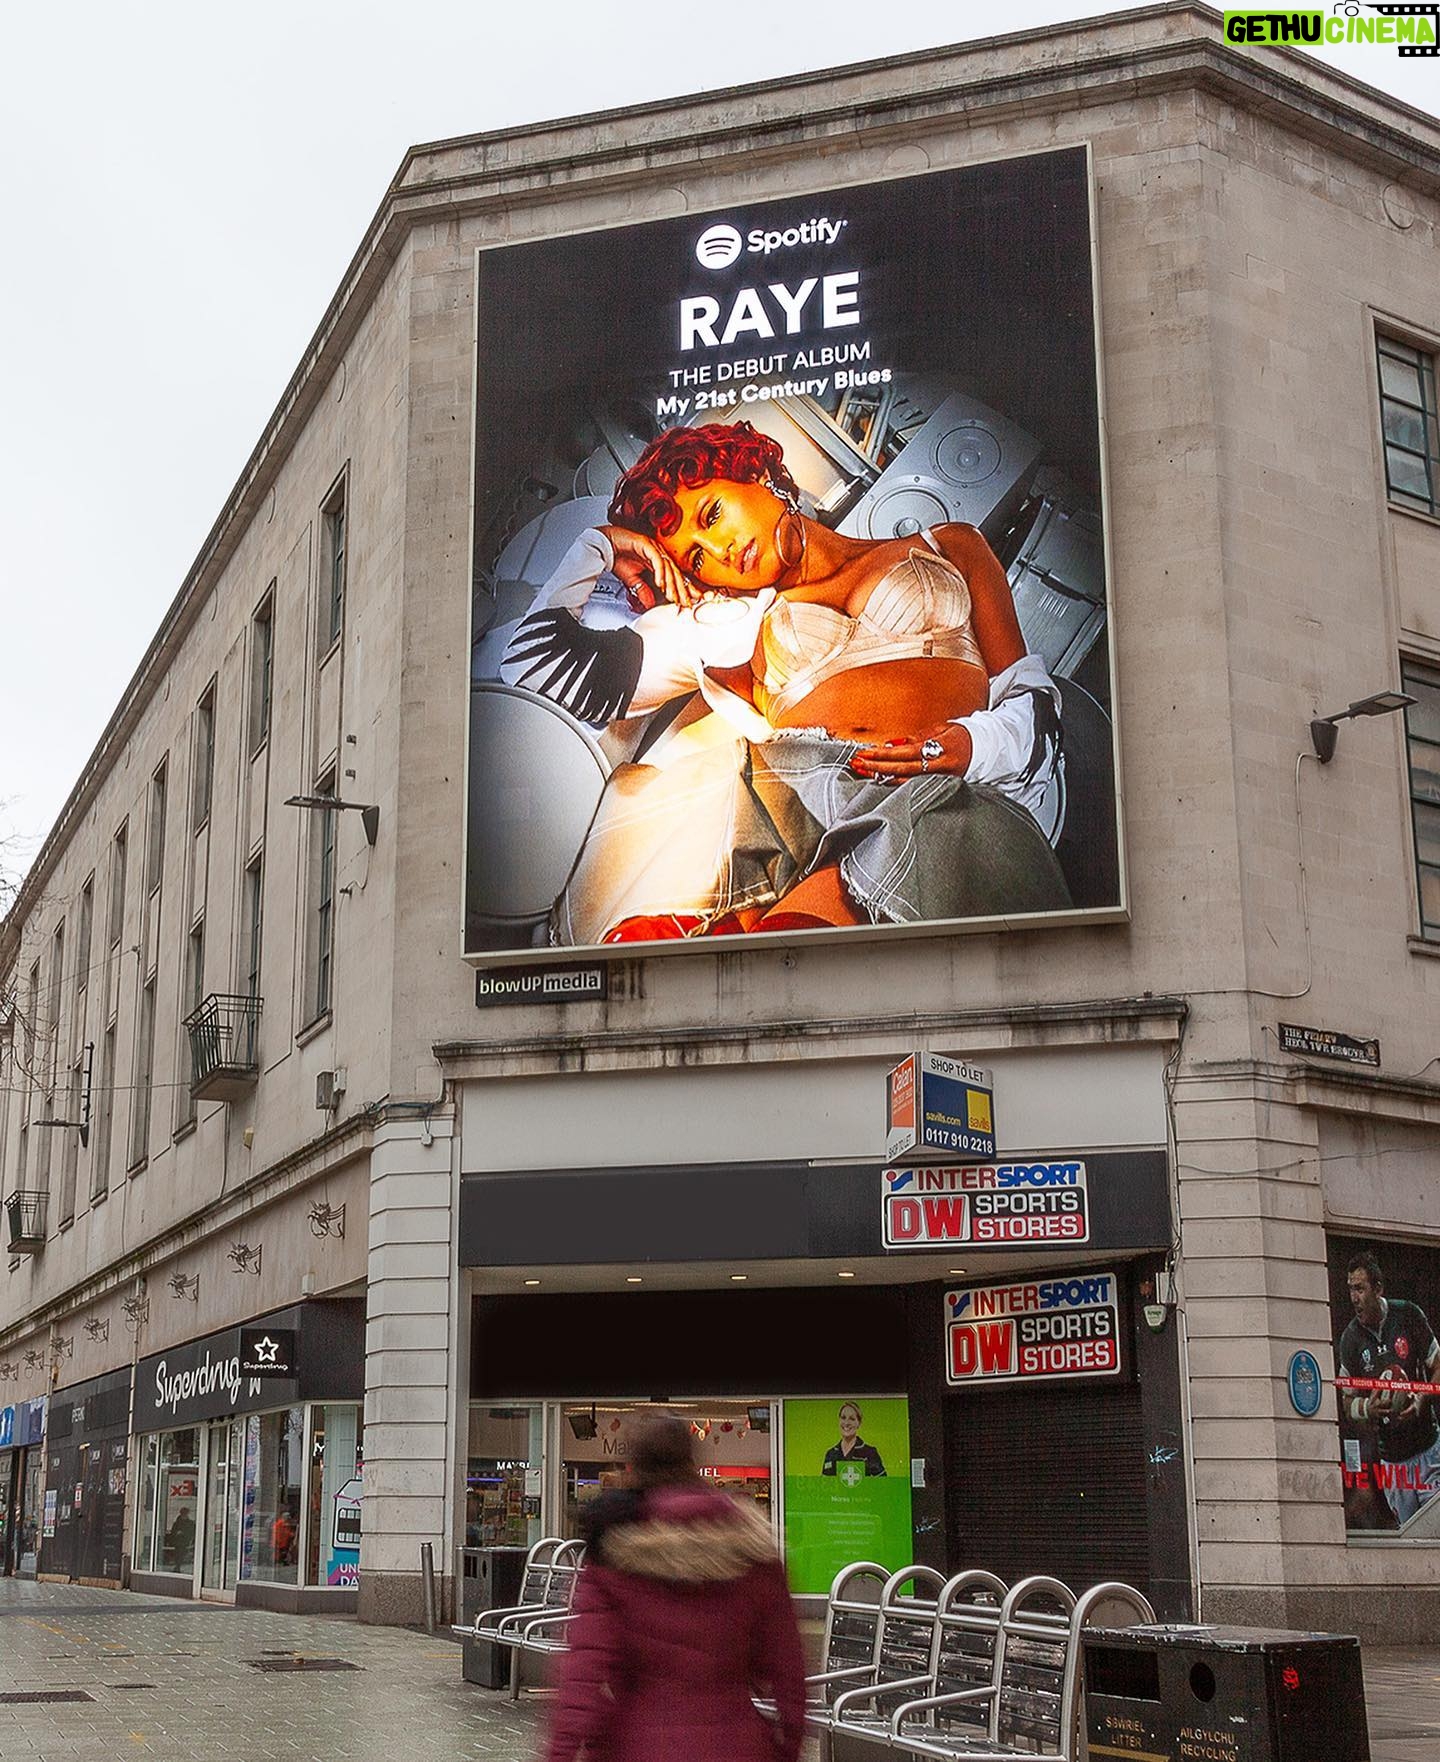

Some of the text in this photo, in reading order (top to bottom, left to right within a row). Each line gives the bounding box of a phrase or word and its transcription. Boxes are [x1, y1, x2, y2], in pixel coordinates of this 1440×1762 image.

[747, 217, 843, 255] Spotify
[680, 271, 860, 351] RAYE
[669, 341, 871, 388] THE DEBUT ALBUM
[656, 366, 893, 417] My 21st Century Blues
[930, 1058, 984, 1083] SHOP TO LET
[925, 1111, 961, 1126] savills.com
[969, 1116, 990, 1129] savills
[926, 1128, 994, 1154] 0117 910 2218
[918, 1163, 1081, 1191] INTERSPORT
[975, 1191, 1079, 1215] SPORTS
[890, 1196, 966, 1241] DW
[978, 1215, 1078, 1239] STORES
[974, 1277, 1111, 1317] INTERSPORT
[1021, 1310, 1110, 1343] SPORTS
[952, 1321, 1014, 1377] DW
[1023, 1340, 1110, 1372] STORES
[243, 1361, 289, 1371] Superdrug
[154, 1350, 242, 1415] Superdrug
[1373, 1462, 1433, 1490] WILL.
[1111, 1733, 1143, 1749] LITTER
[1180, 1726, 1236, 1746] AILGYLCHU
[1180, 1742, 1237, 1762] RECYCLING
